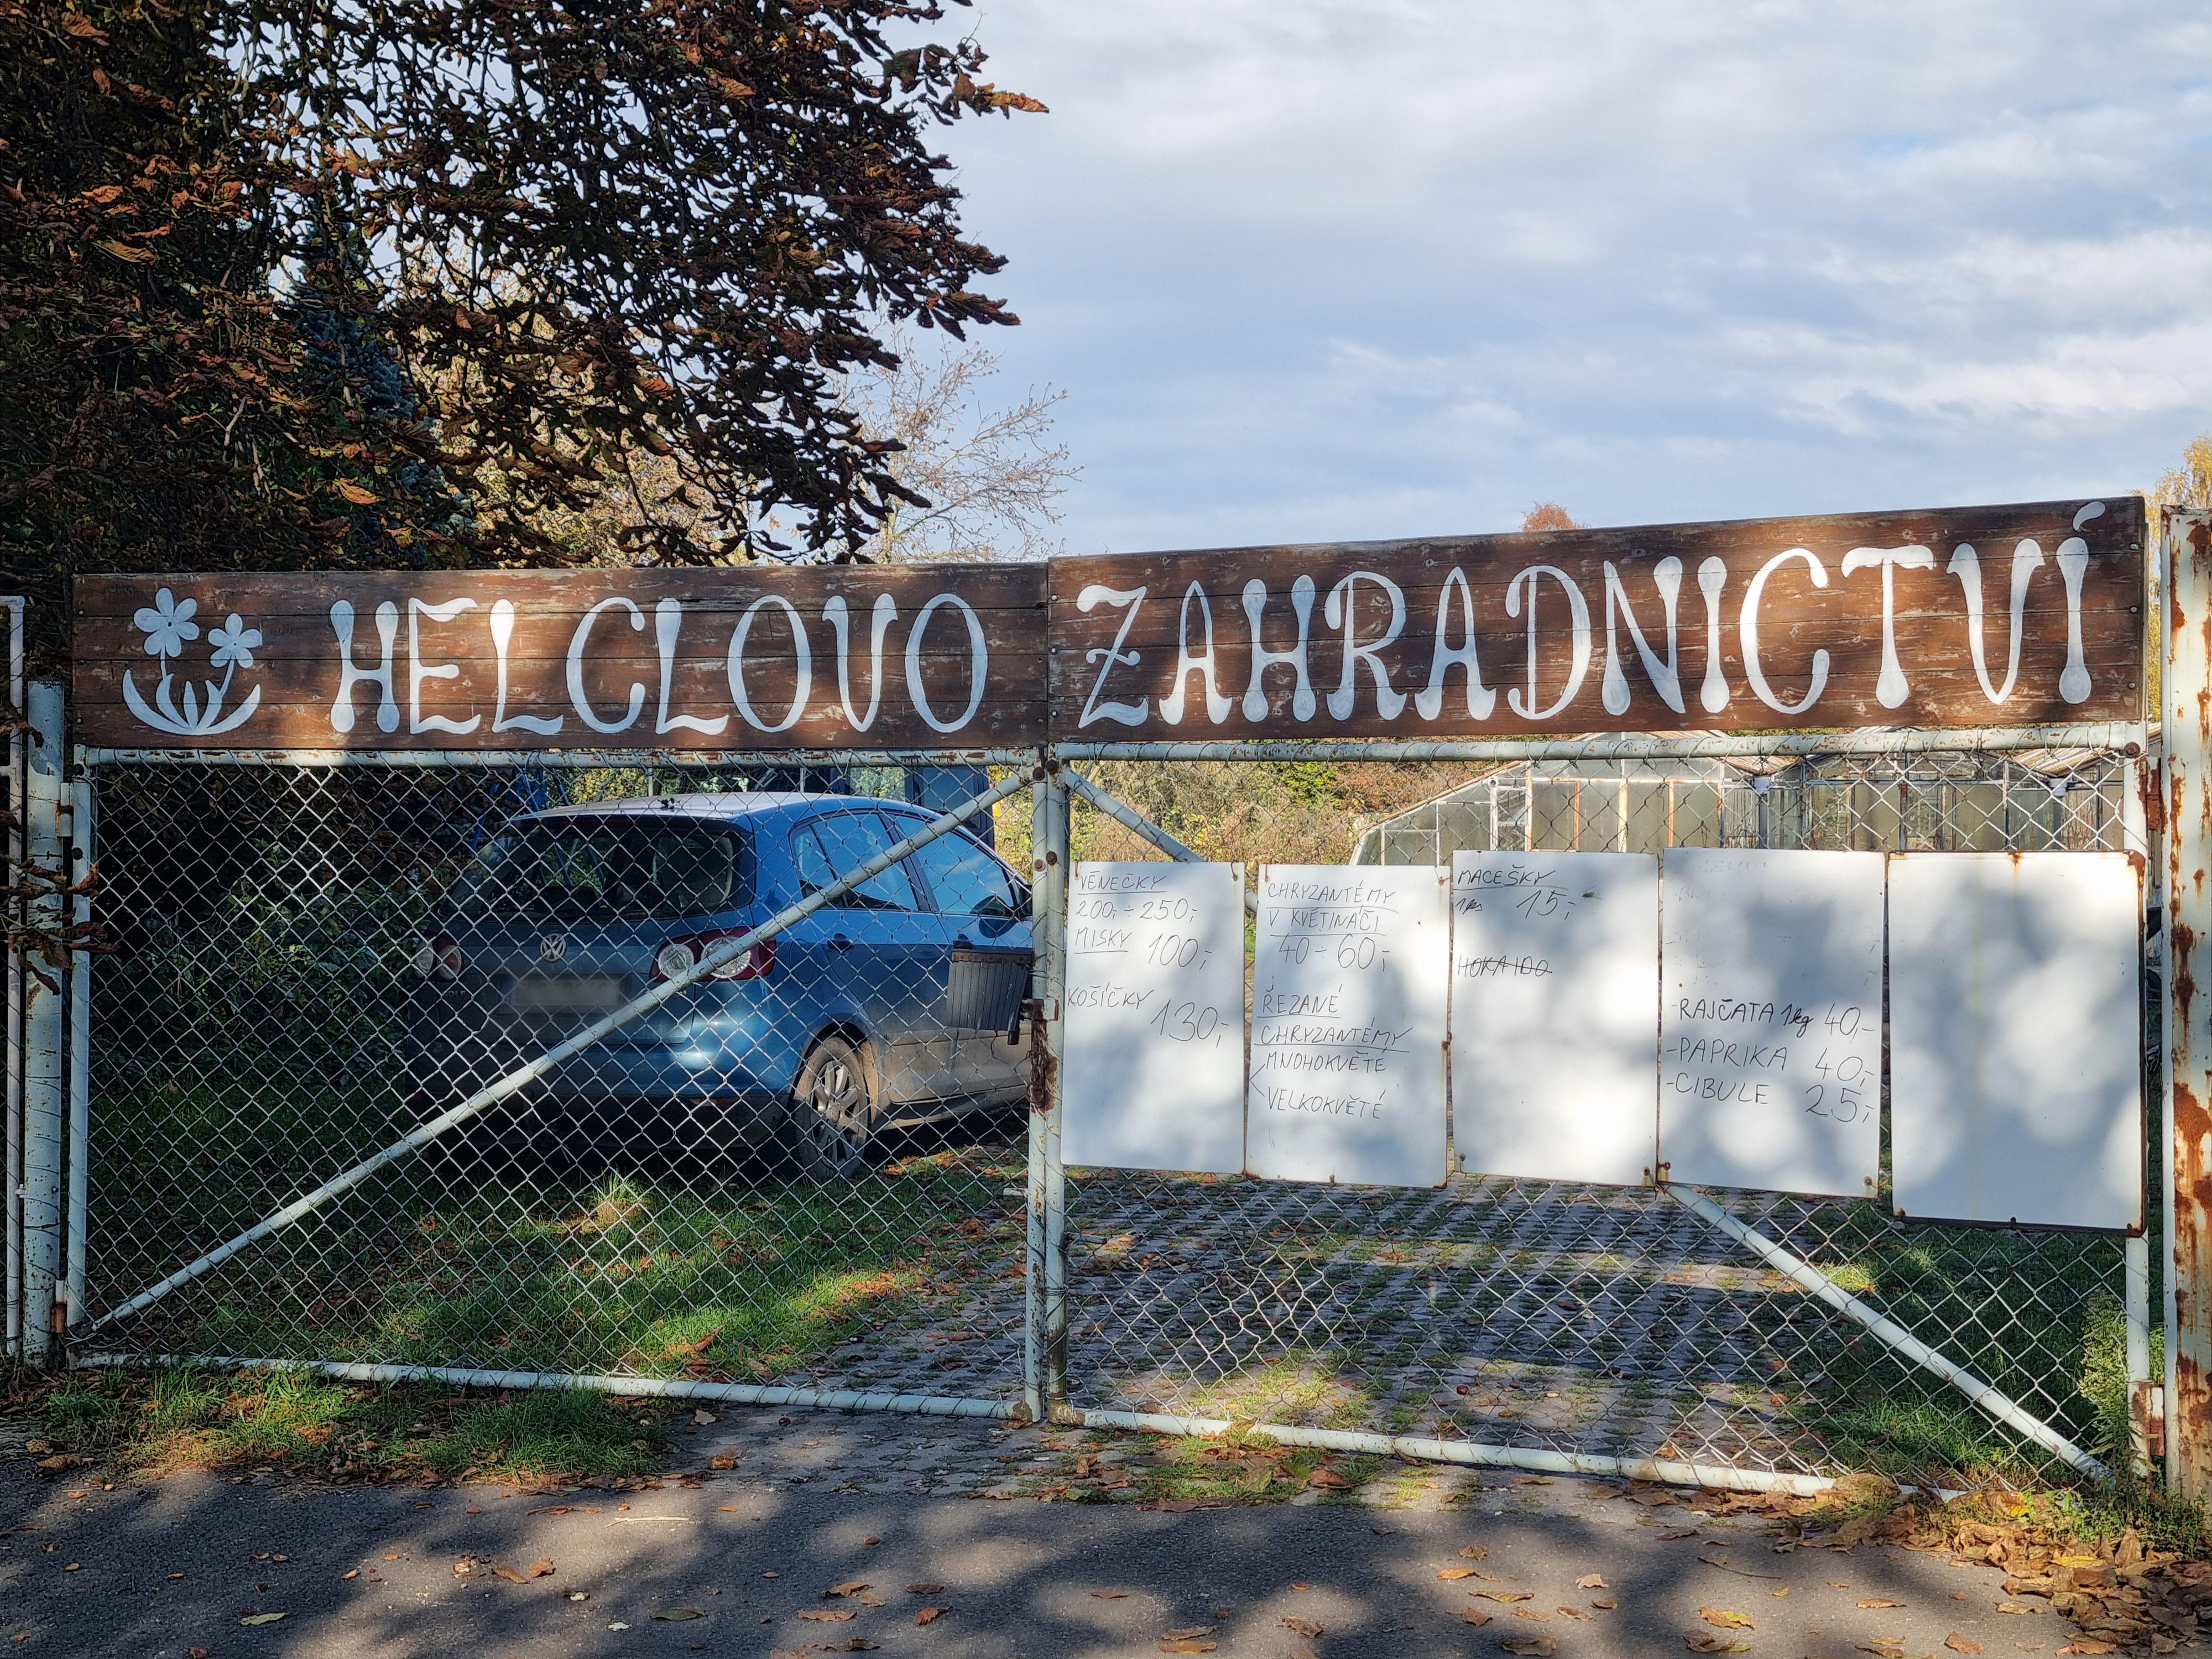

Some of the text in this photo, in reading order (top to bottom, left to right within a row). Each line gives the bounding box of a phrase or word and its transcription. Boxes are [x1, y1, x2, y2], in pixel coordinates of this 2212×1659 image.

[330, 501, 2106, 734] HELCLOVO ZAHRADNICTVÍ
[1458, 864, 1556, 885] MACEŠKY
[1267, 880, 1396, 904] CHRYZANTÉMY
[1269, 909, 1280, 927] V
[1074, 927, 1133, 948] MISKY
[1279, 933, 1310, 964] 40
[1261, 1017, 1413, 1046] CHRYZANTÉMY
